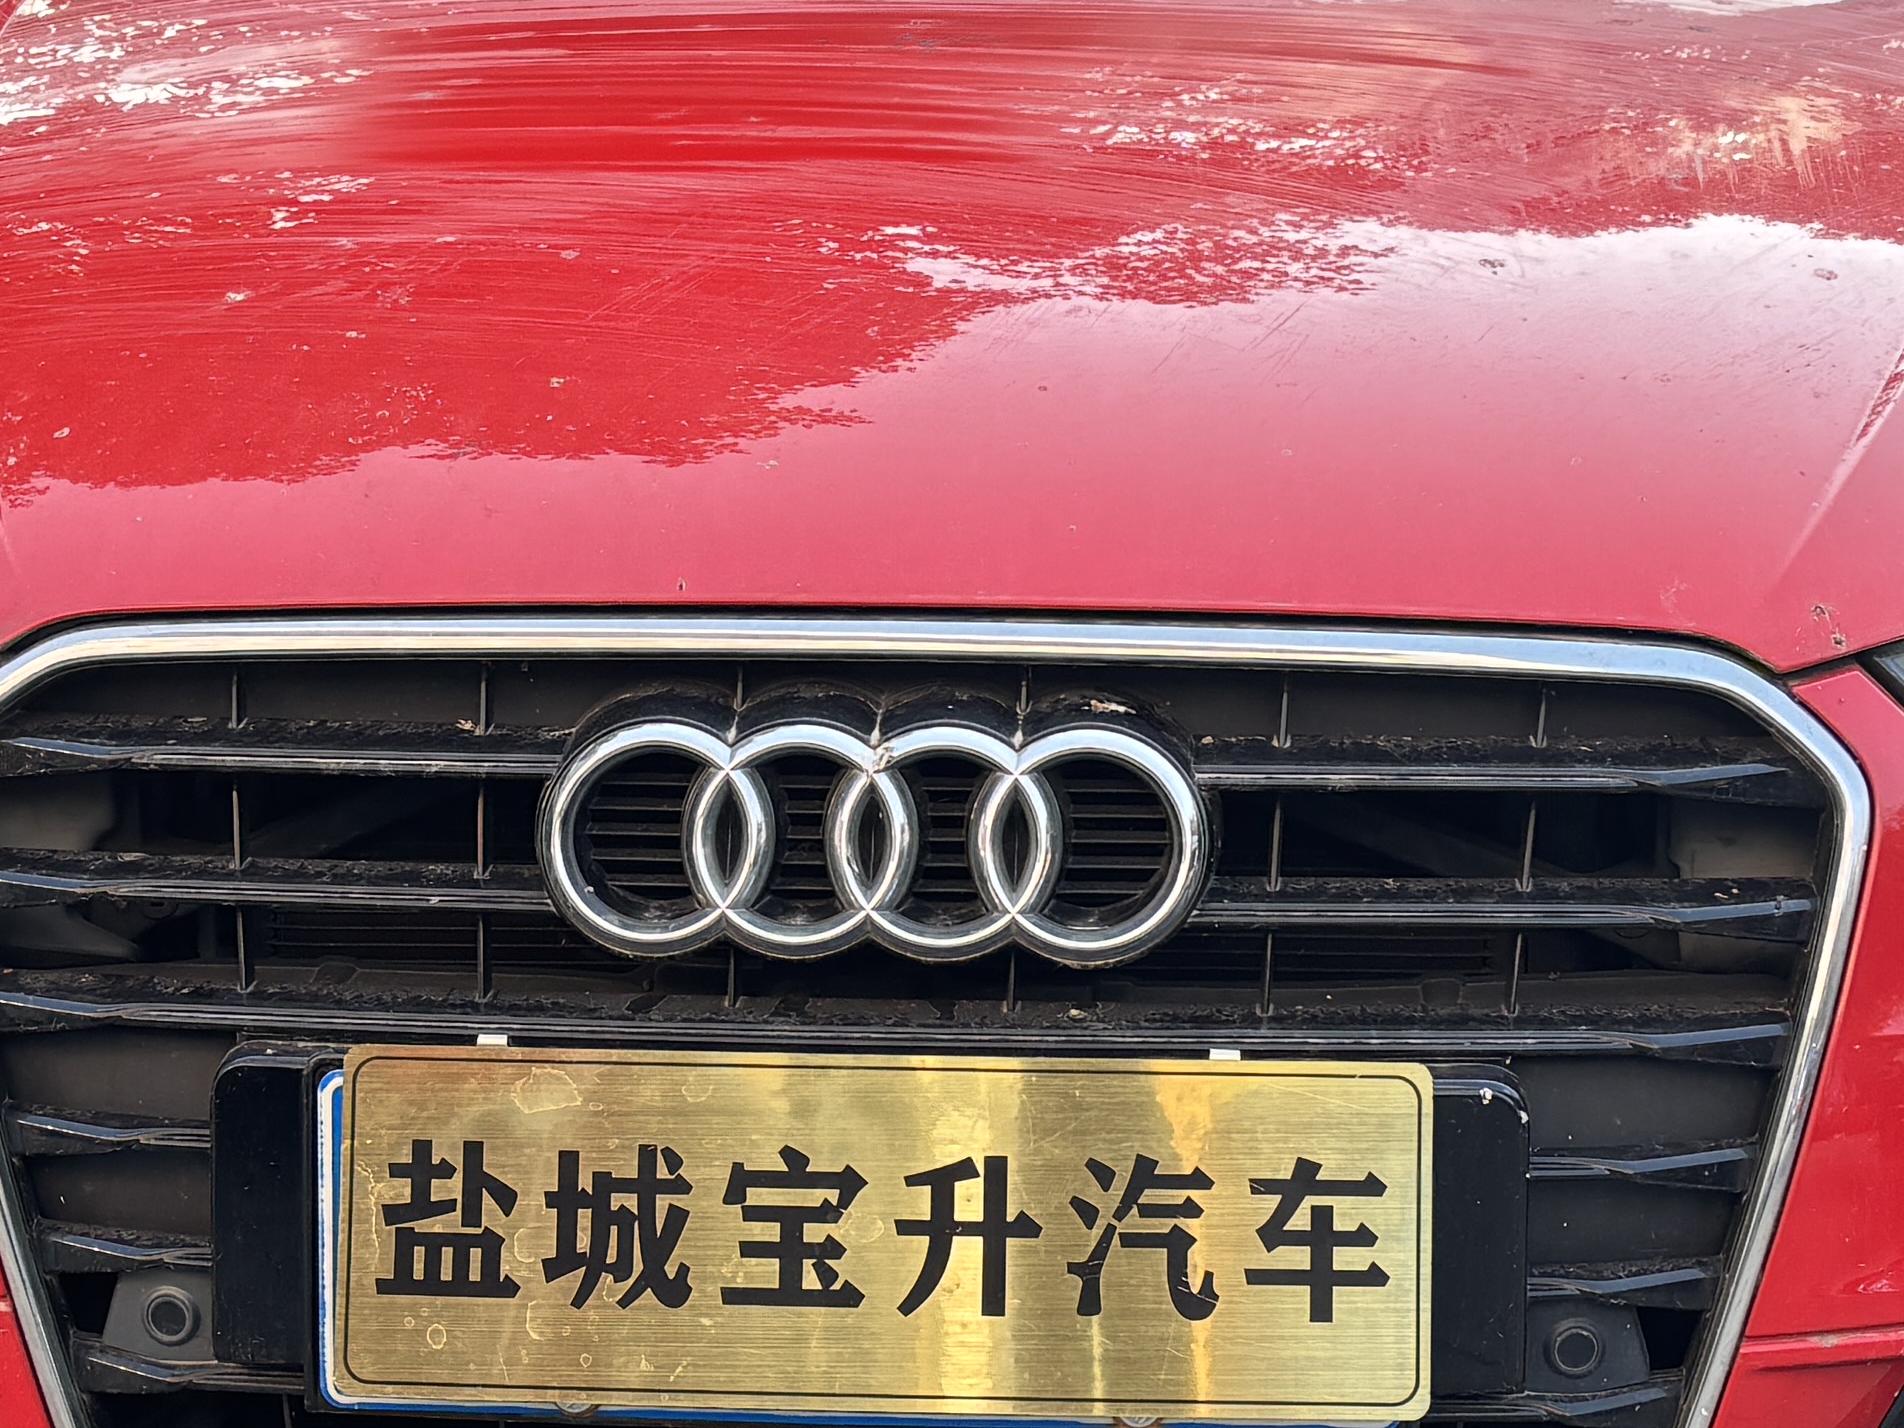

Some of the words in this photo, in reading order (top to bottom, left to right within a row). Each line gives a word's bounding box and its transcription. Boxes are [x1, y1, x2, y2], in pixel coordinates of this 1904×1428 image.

[374, 1138, 1390, 1323] 盐城宝升汽车
